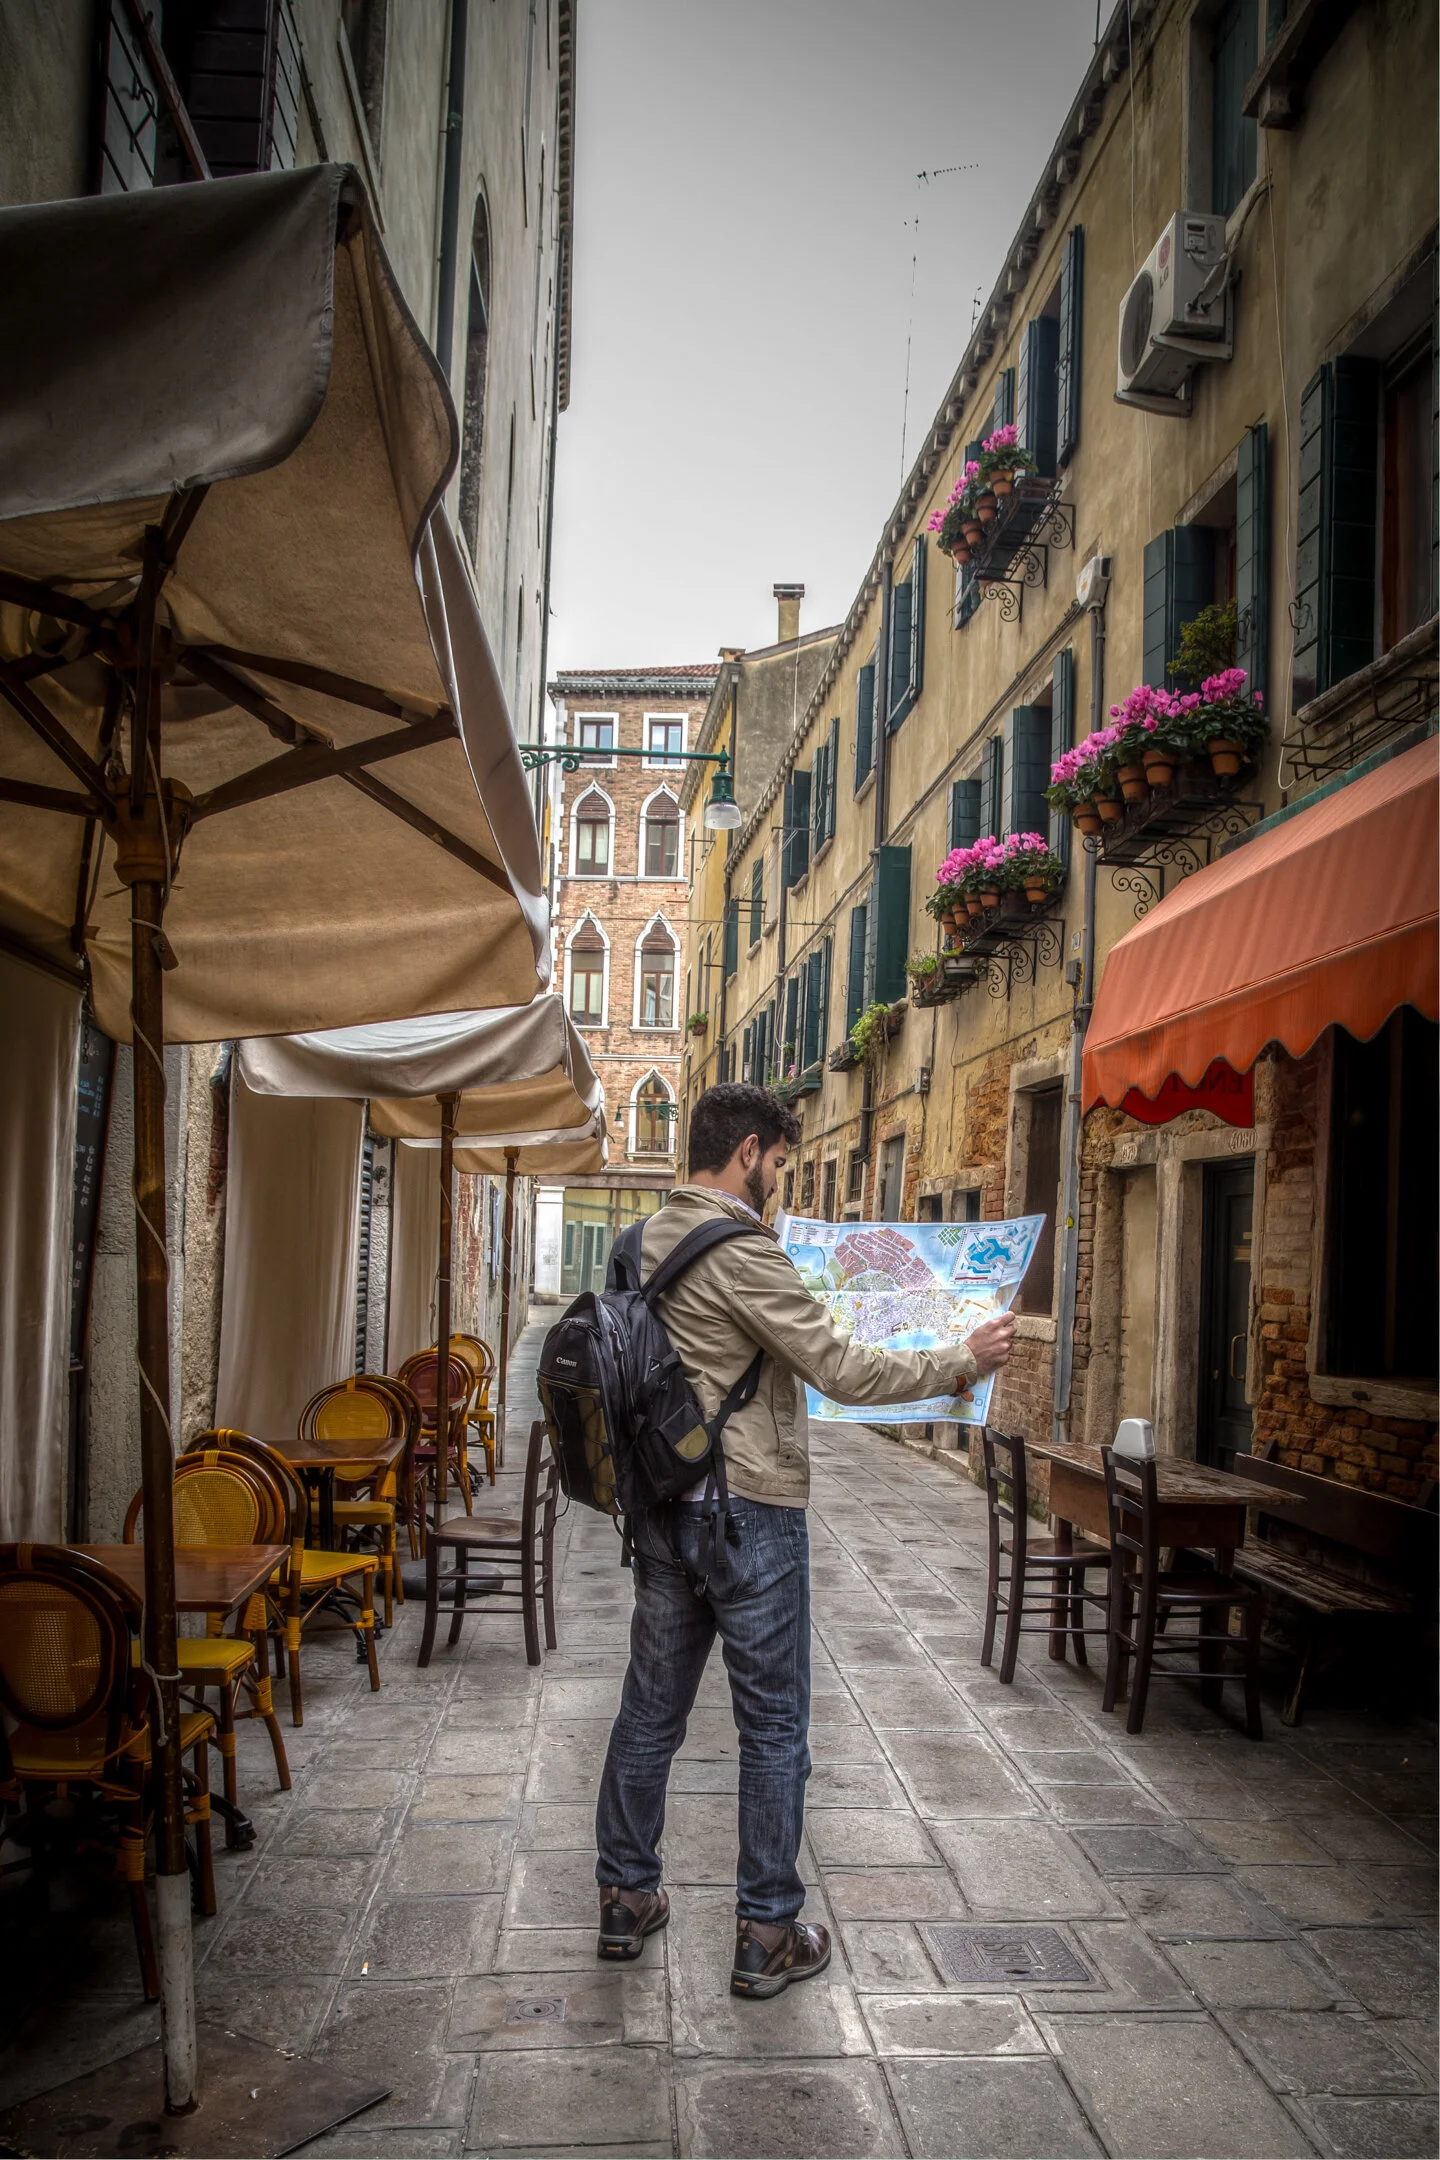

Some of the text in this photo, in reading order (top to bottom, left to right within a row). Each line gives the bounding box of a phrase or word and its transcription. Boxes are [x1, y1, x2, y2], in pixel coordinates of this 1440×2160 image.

[1160, 266, 1169, 289] LG
[1231, 1131, 1256, 1149] 4080
[556, 1356, 577, 1367] Canon
